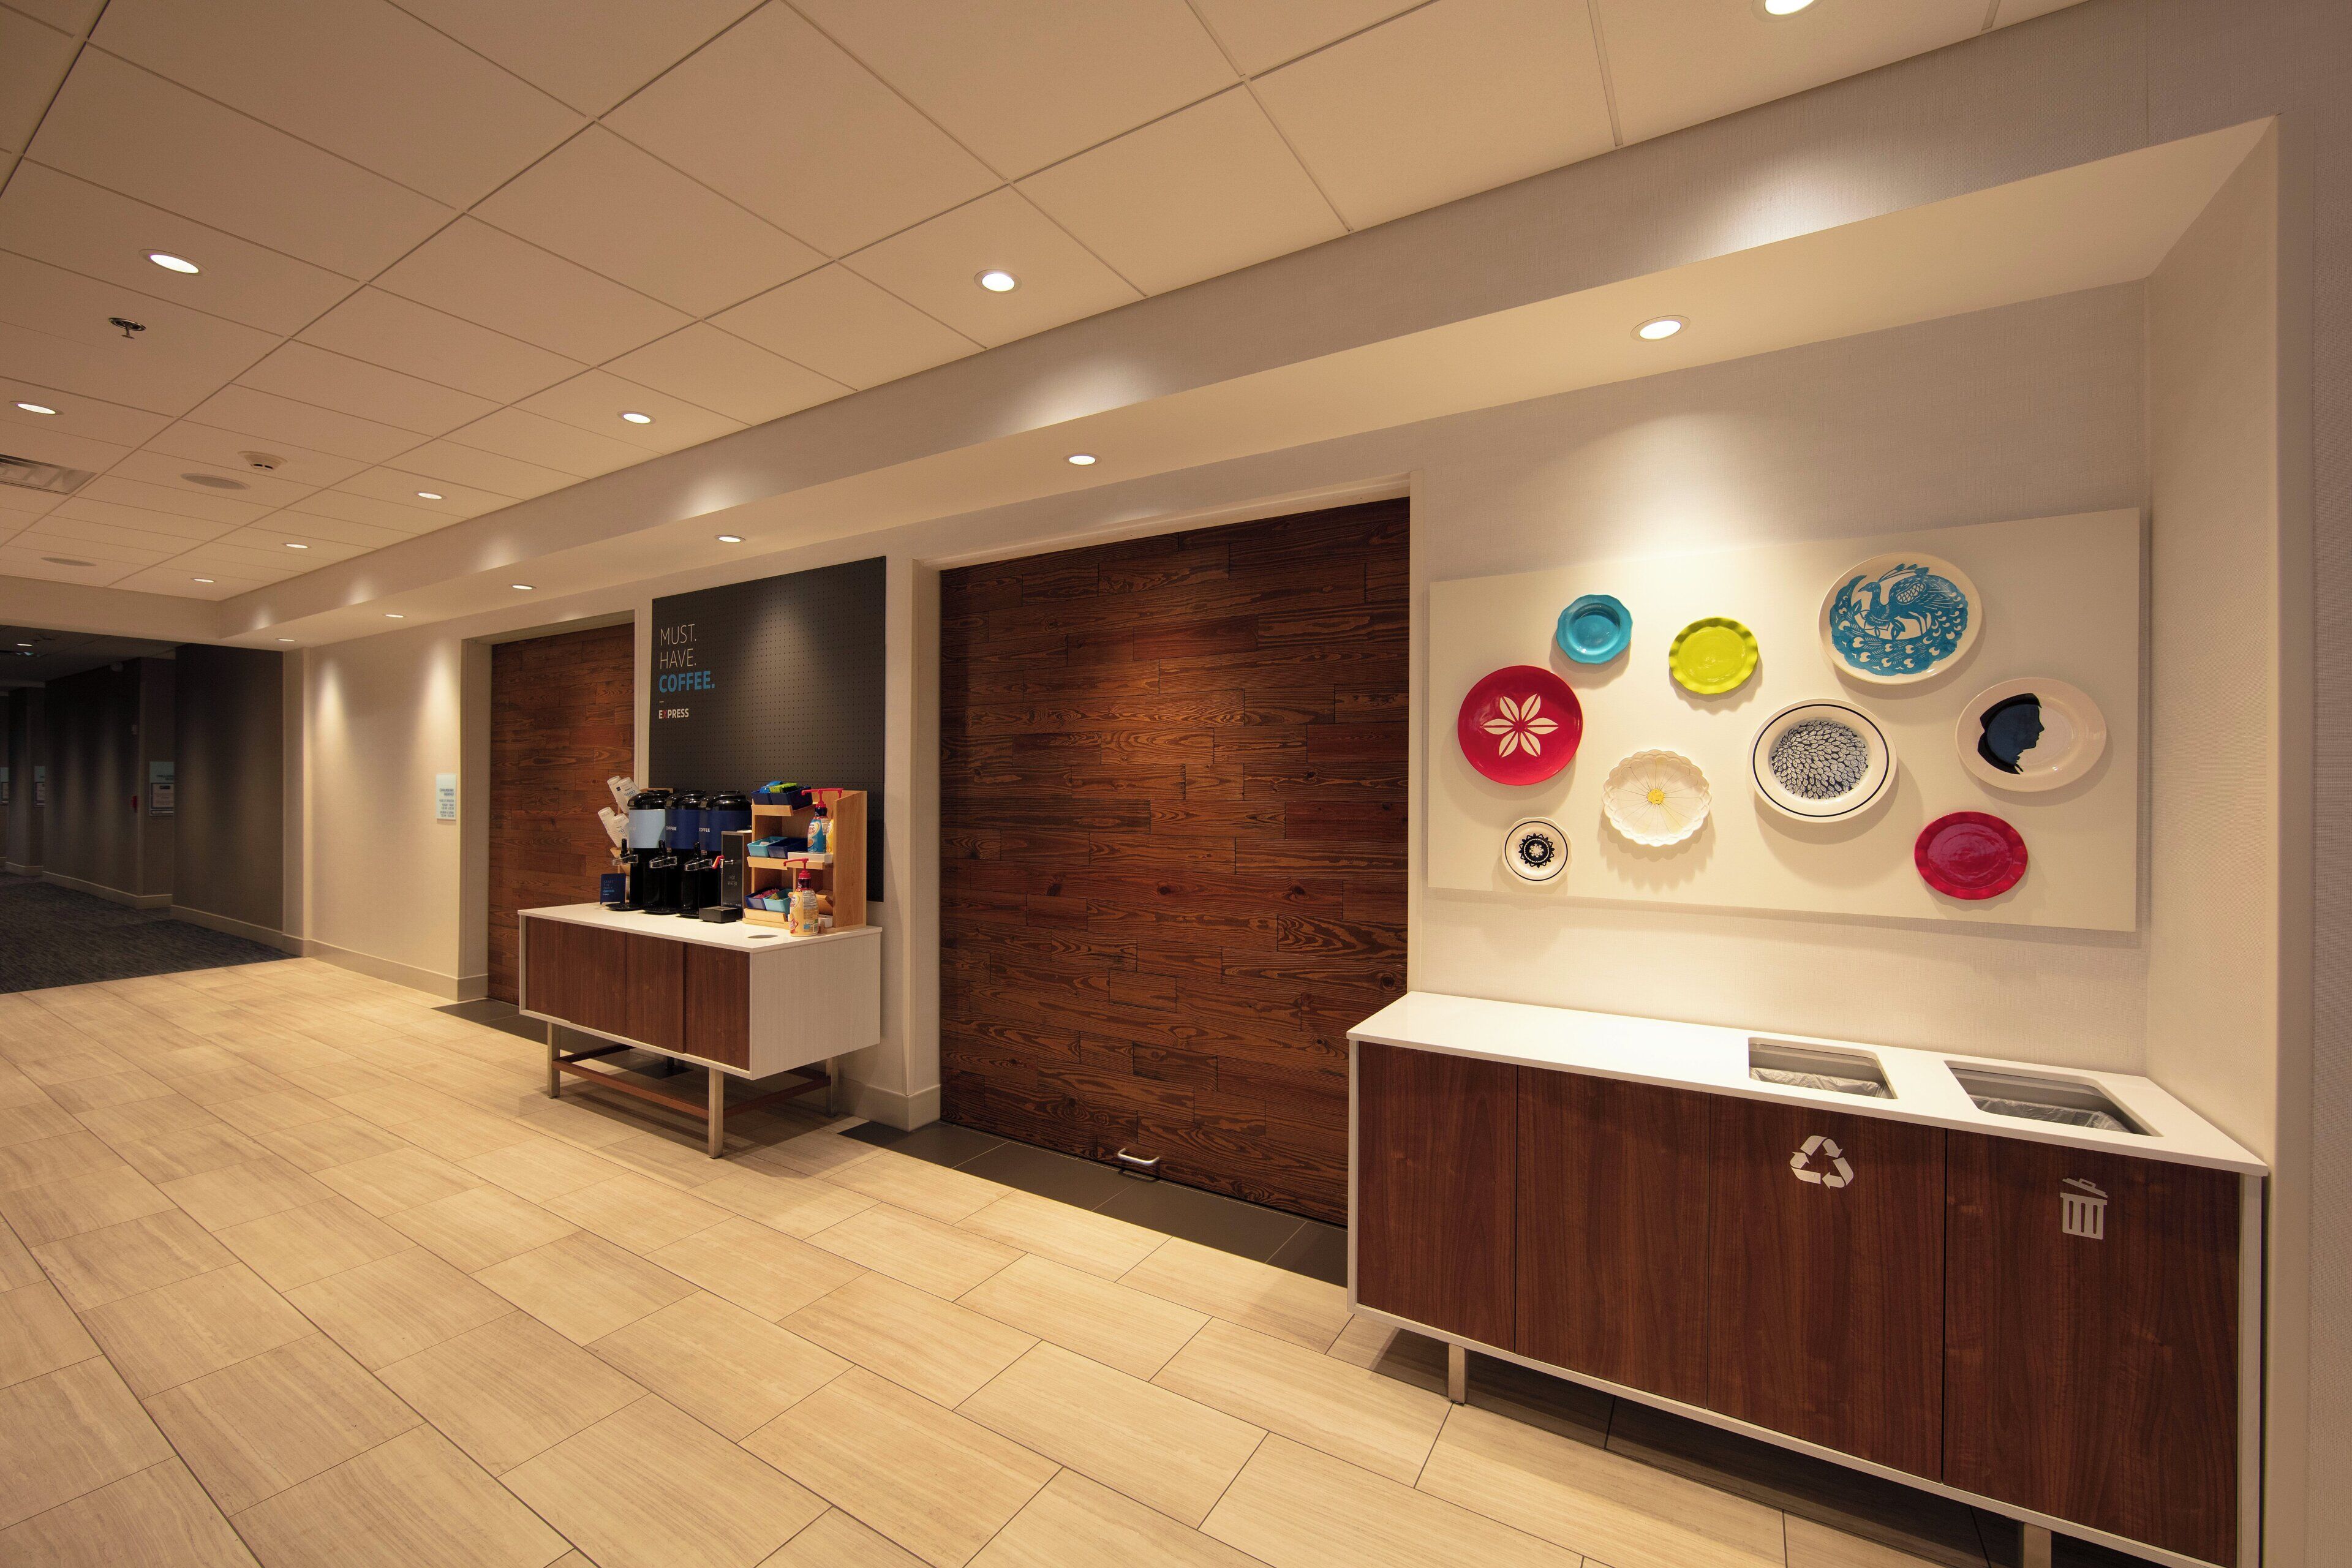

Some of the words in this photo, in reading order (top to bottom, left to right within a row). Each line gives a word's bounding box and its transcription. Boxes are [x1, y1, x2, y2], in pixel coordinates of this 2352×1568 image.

[660, 624, 696, 646] MUST.
[660, 648, 696, 669] HAVE.
[659, 671, 715, 693] COFFEE.
[658, 708, 689, 719] EXPRESS
